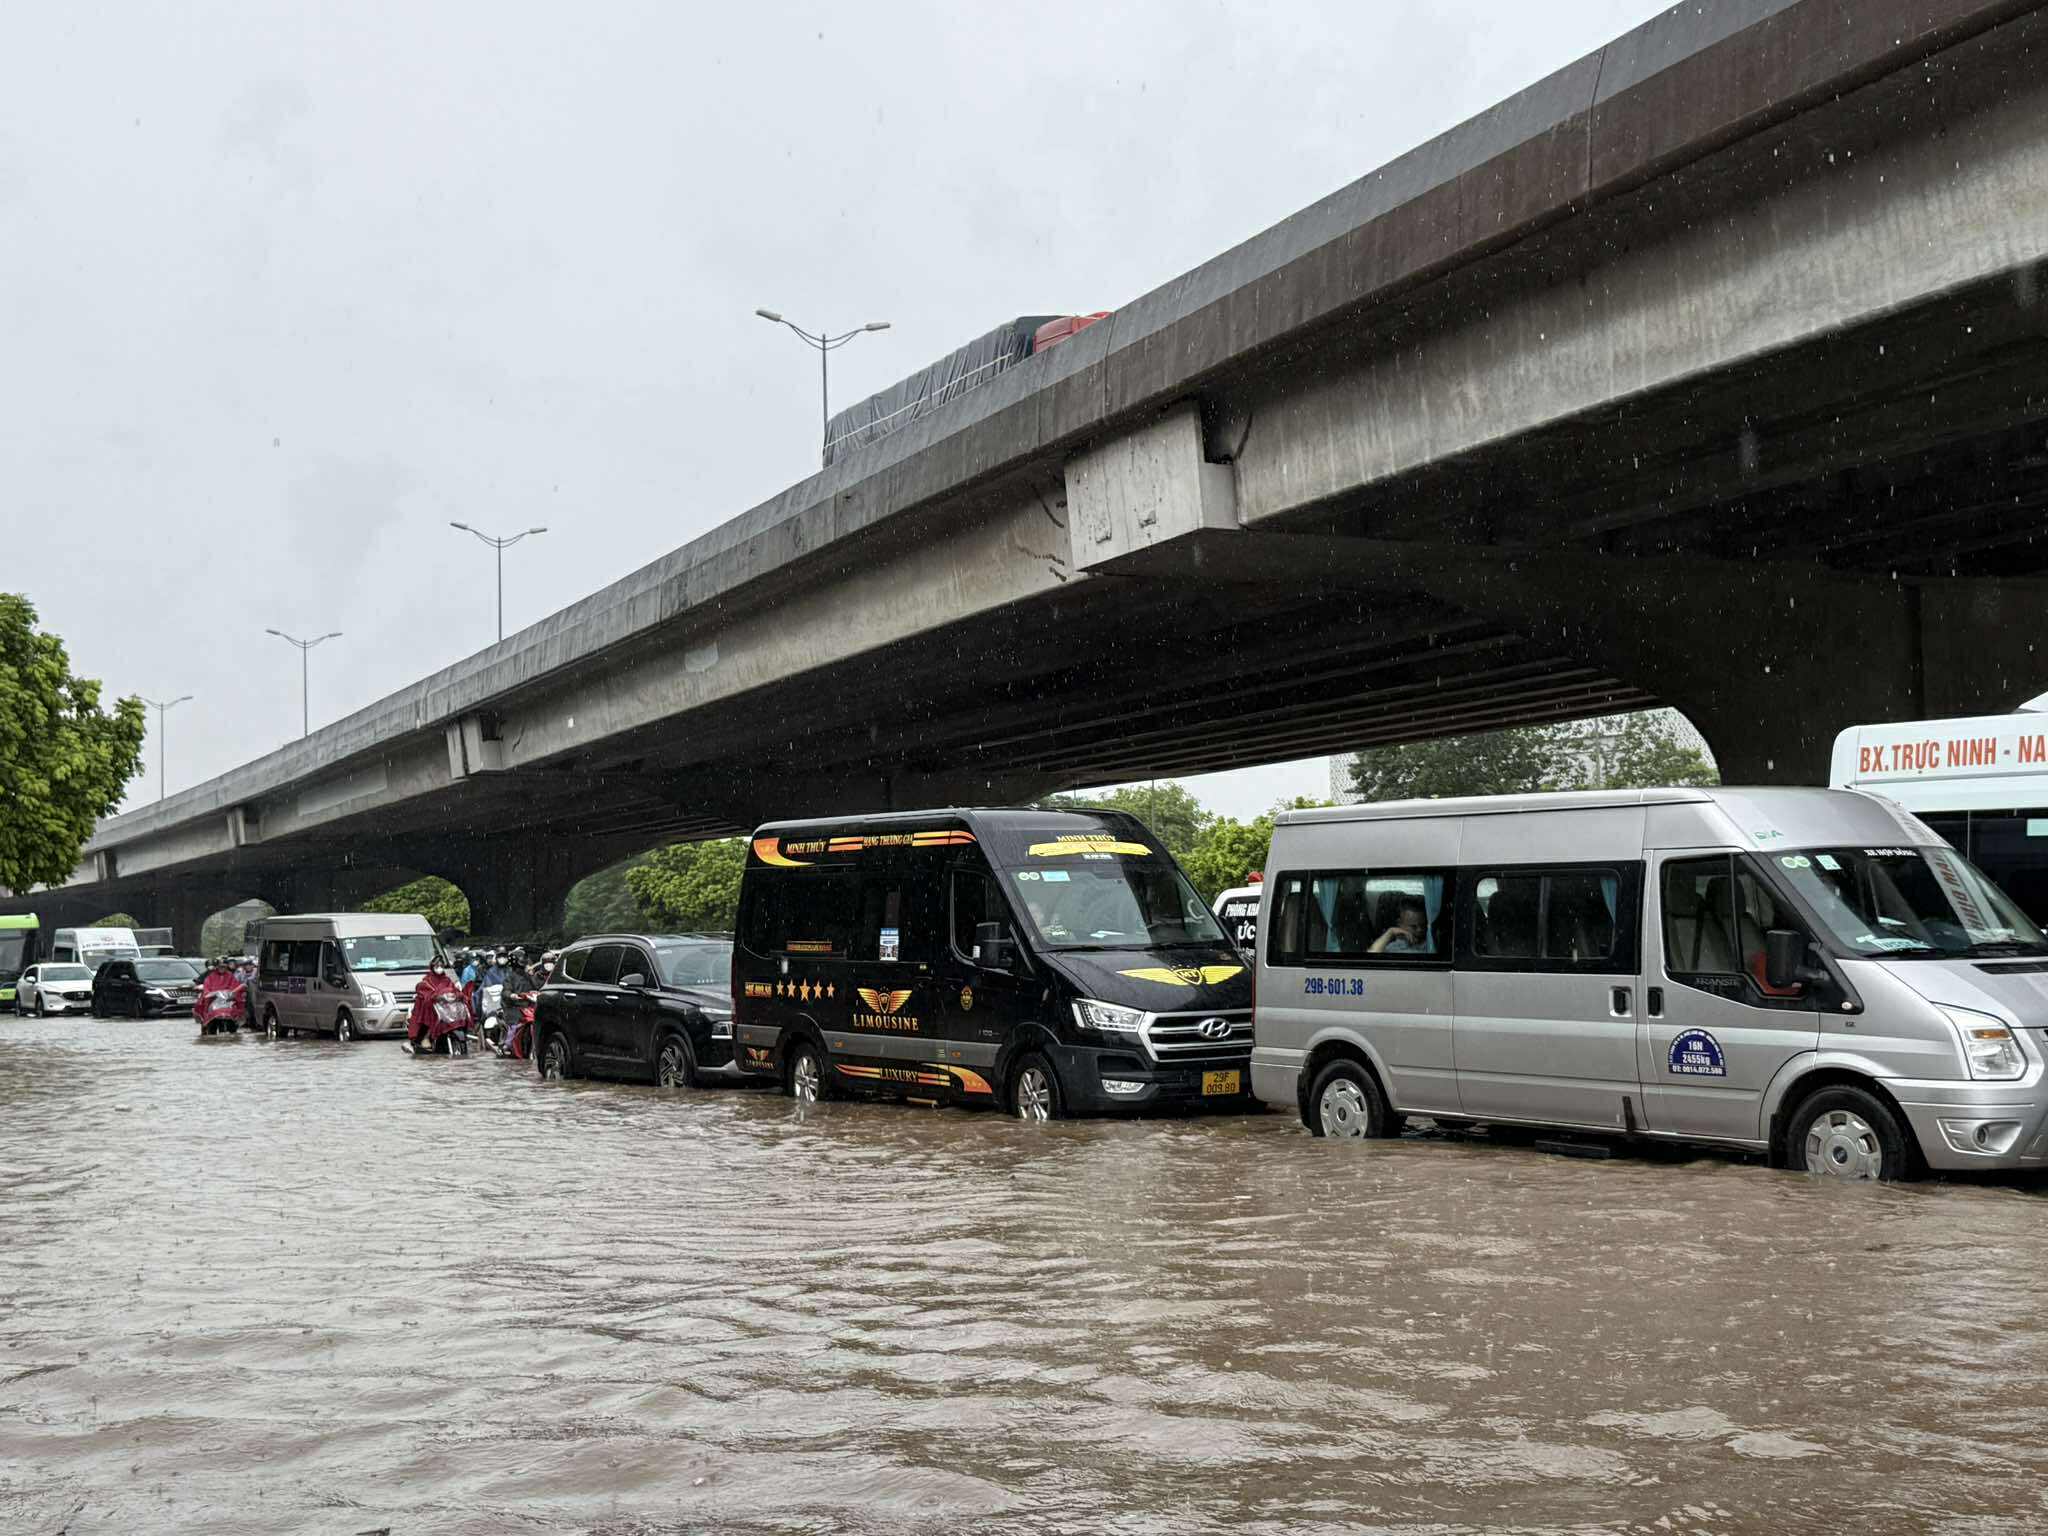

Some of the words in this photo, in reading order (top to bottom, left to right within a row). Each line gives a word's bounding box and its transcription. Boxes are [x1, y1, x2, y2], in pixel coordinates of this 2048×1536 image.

[1947, 737, 1997, 767] NINH
[2018, 735, 2047, 764] NA
[853, 1014, 919, 1031] LIMOUSINE
[880, 1068, 918, 1083] LUXURY
